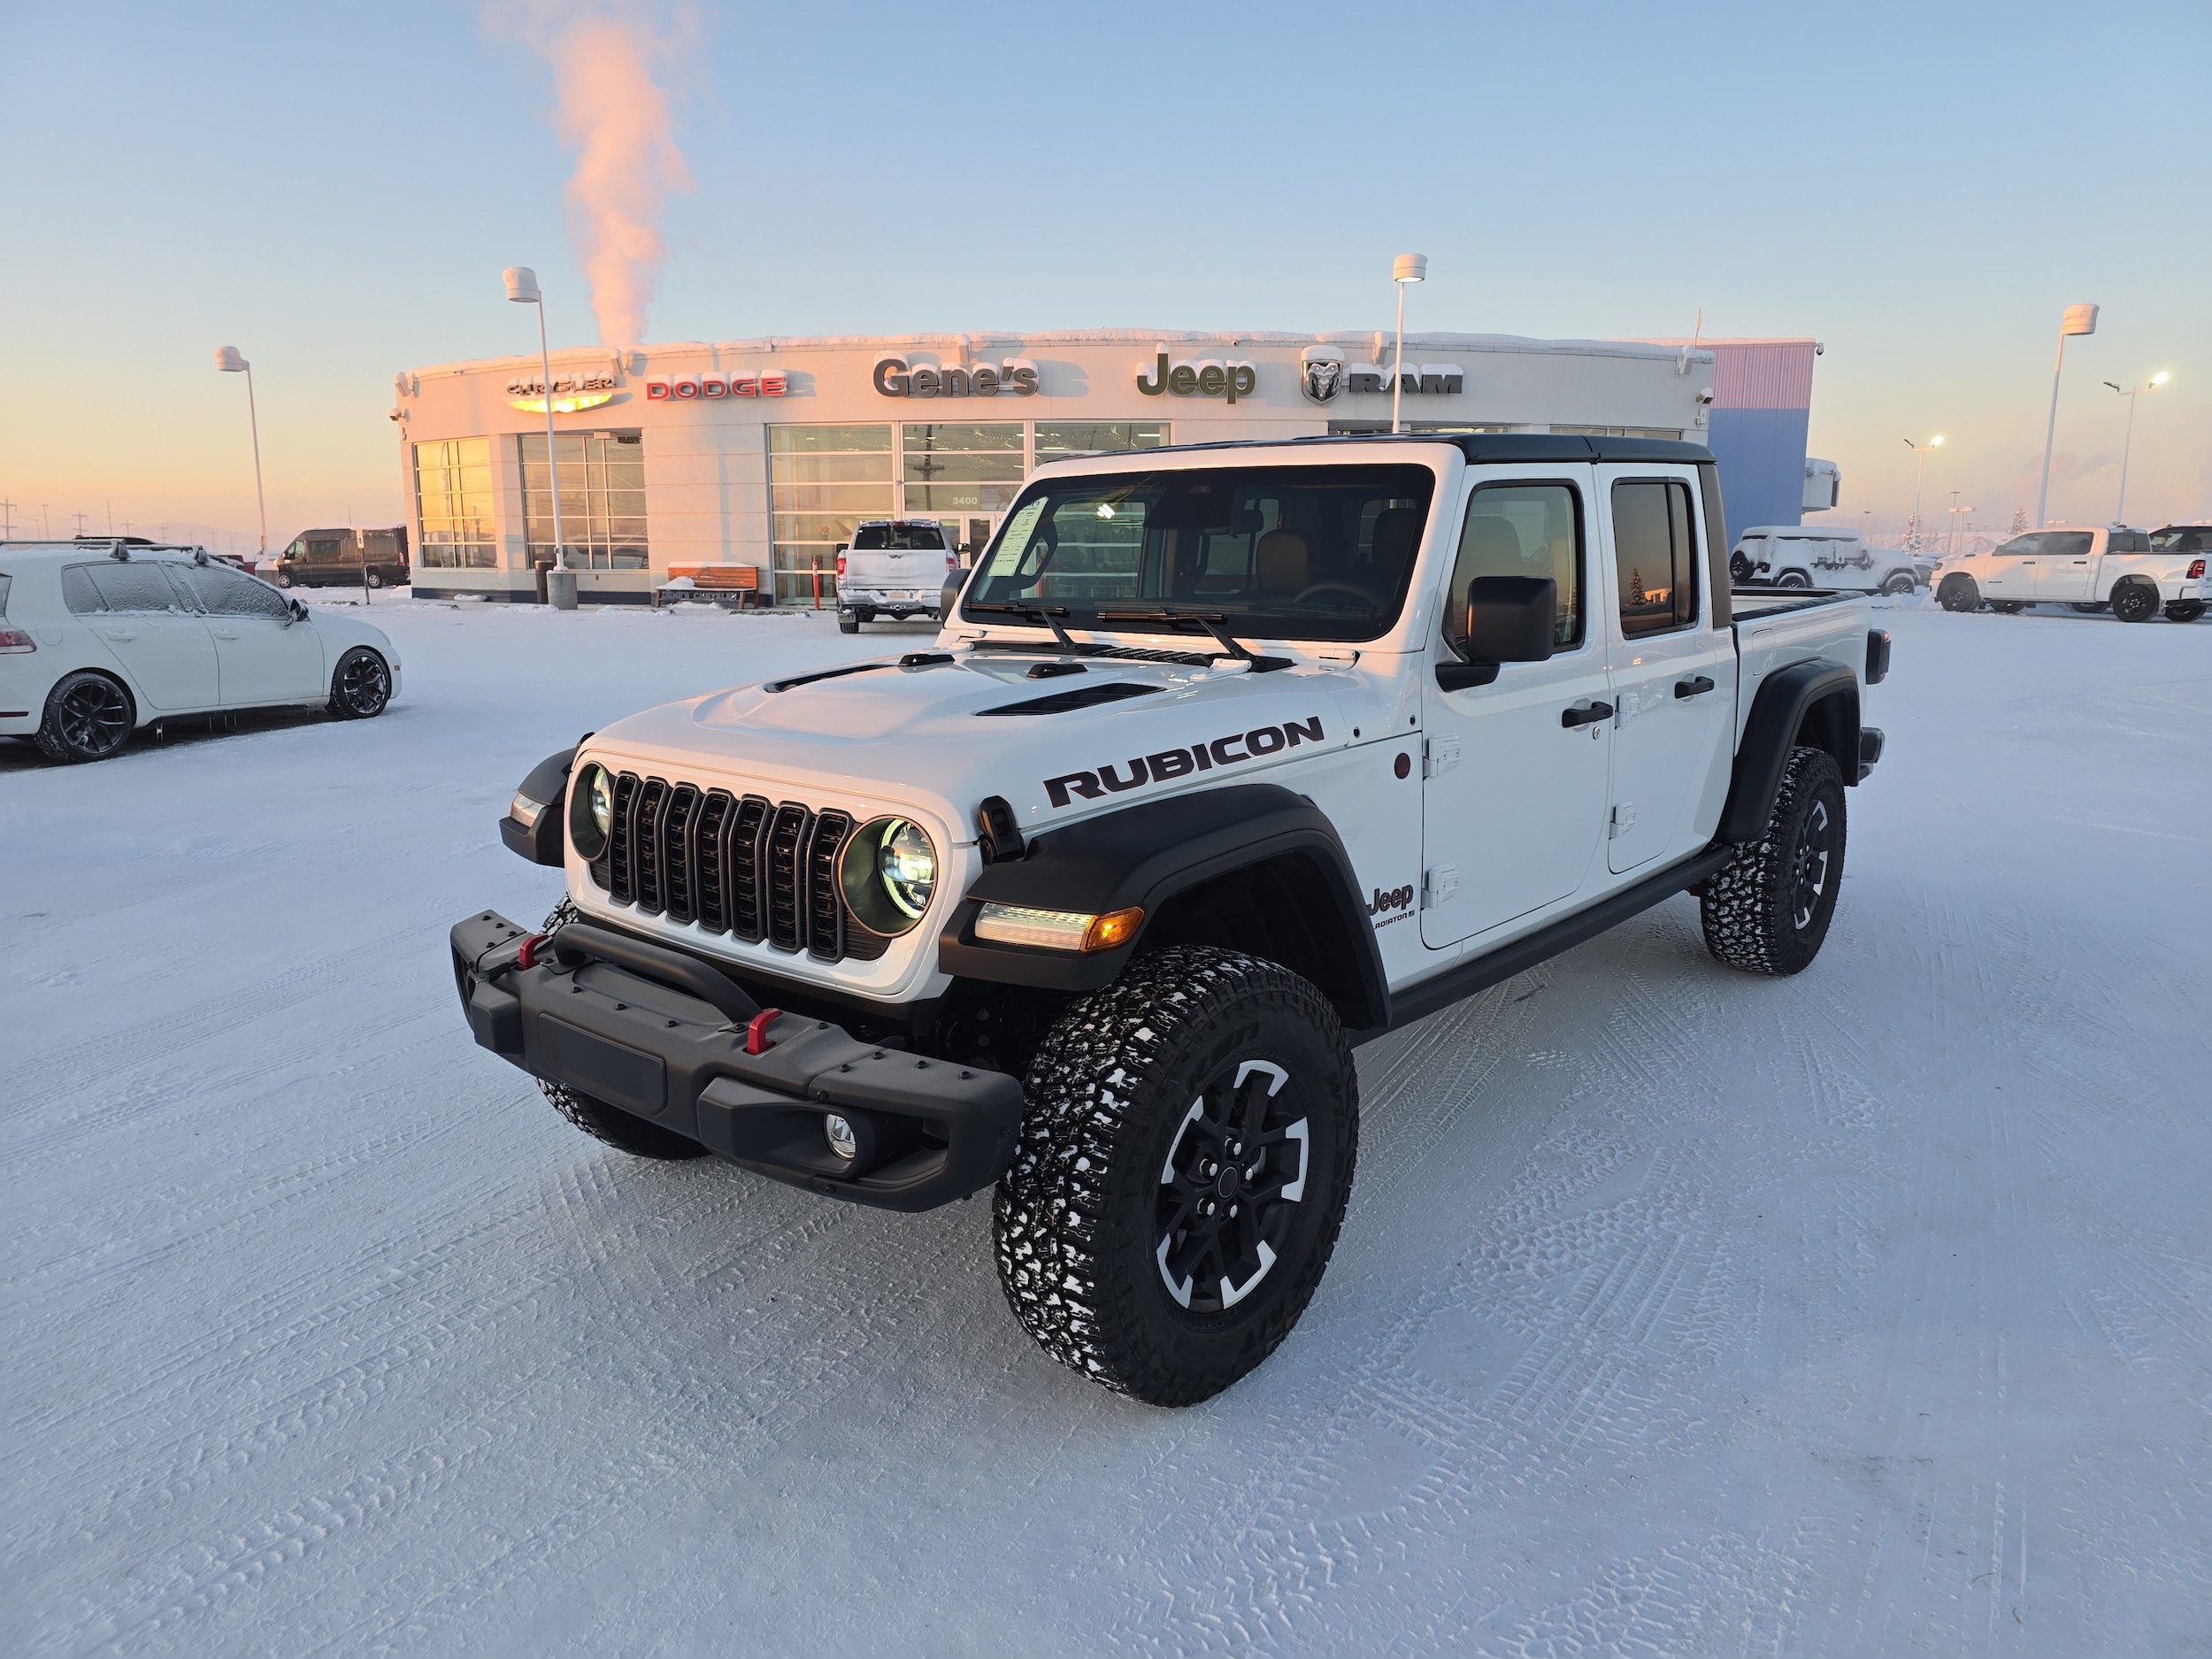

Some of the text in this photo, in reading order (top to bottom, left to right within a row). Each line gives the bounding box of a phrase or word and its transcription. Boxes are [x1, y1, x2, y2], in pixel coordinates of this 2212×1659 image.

[647, 378, 785, 400] DODGE
[873, 359, 1038, 396] Gene's
[1138, 353, 1256, 404] Jeep
[1349, 373, 1463, 394] RAM
[1043, 716, 1325, 809] RUBICON
[1366, 885, 1413, 916] Jeep
[1373, 912, 1408, 930] ADIATOR
